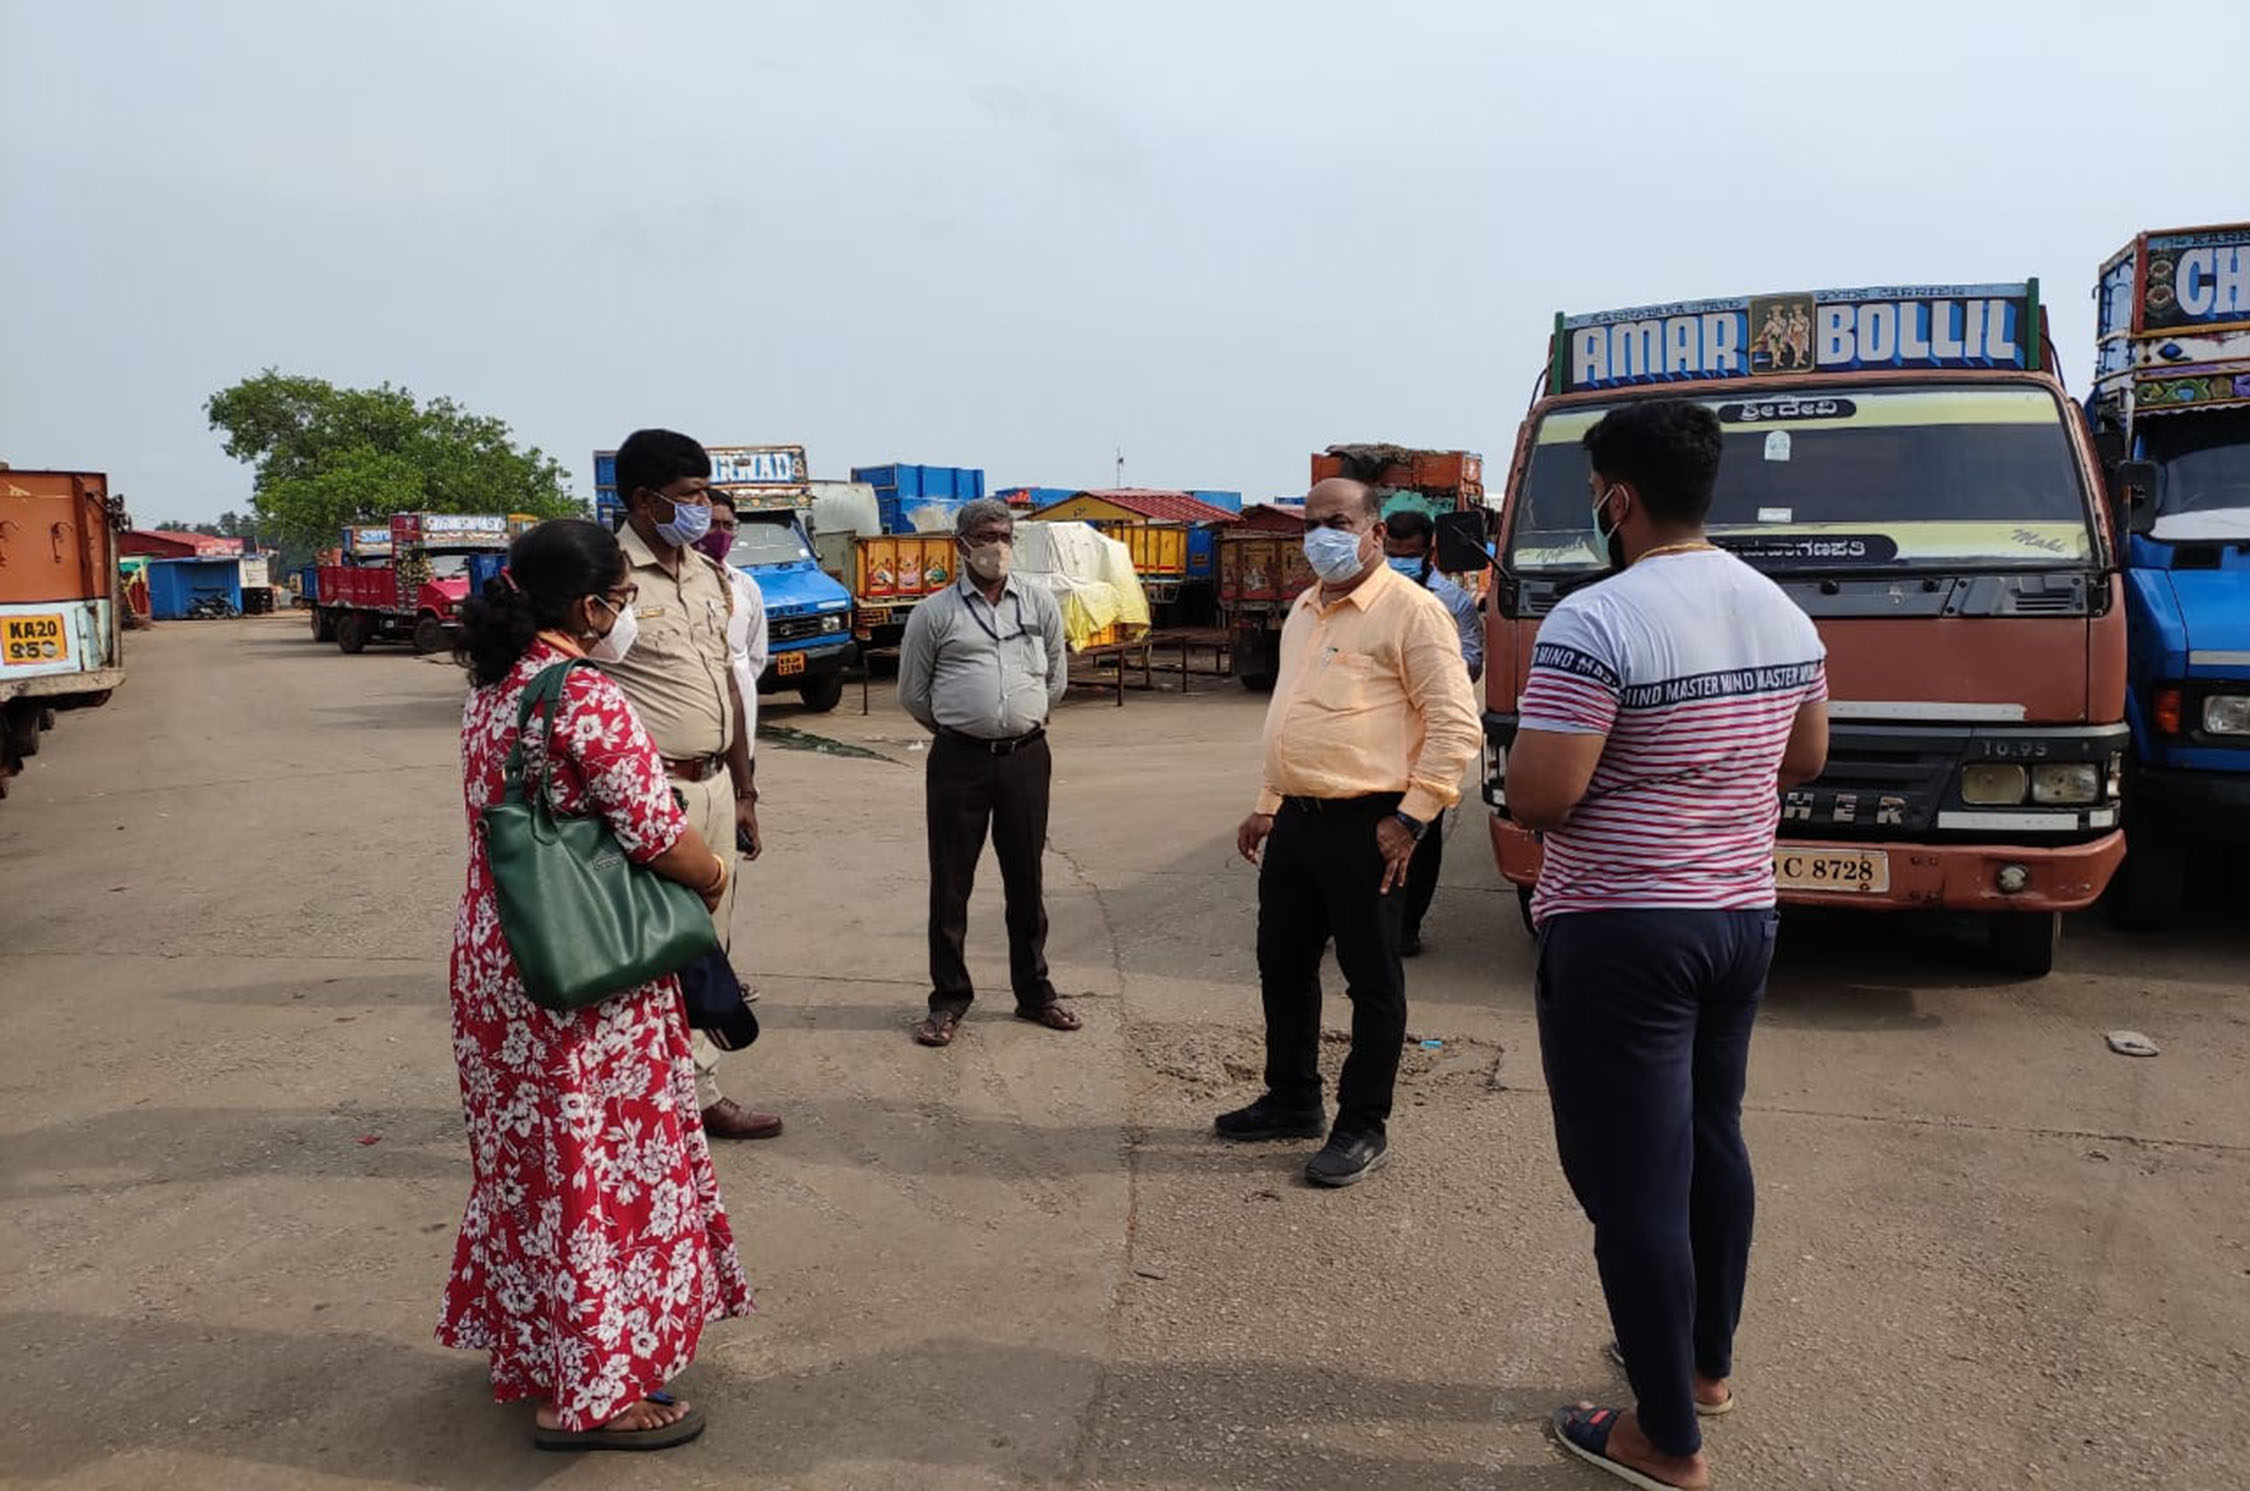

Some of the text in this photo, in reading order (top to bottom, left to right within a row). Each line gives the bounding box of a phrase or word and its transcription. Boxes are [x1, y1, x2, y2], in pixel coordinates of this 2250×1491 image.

[1878, 285, 1964, 298] CARRIER
[1572, 299, 2018, 385] AMAR BOLLIL
[9, 620, 57, 639] KA20
[1666, 676, 1718, 702] MASTER
[1720, 672, 1754, 693] MIND
[1756, 667, 1798, 690] MASTER
[1812, 859, 1874, 882] 8728
